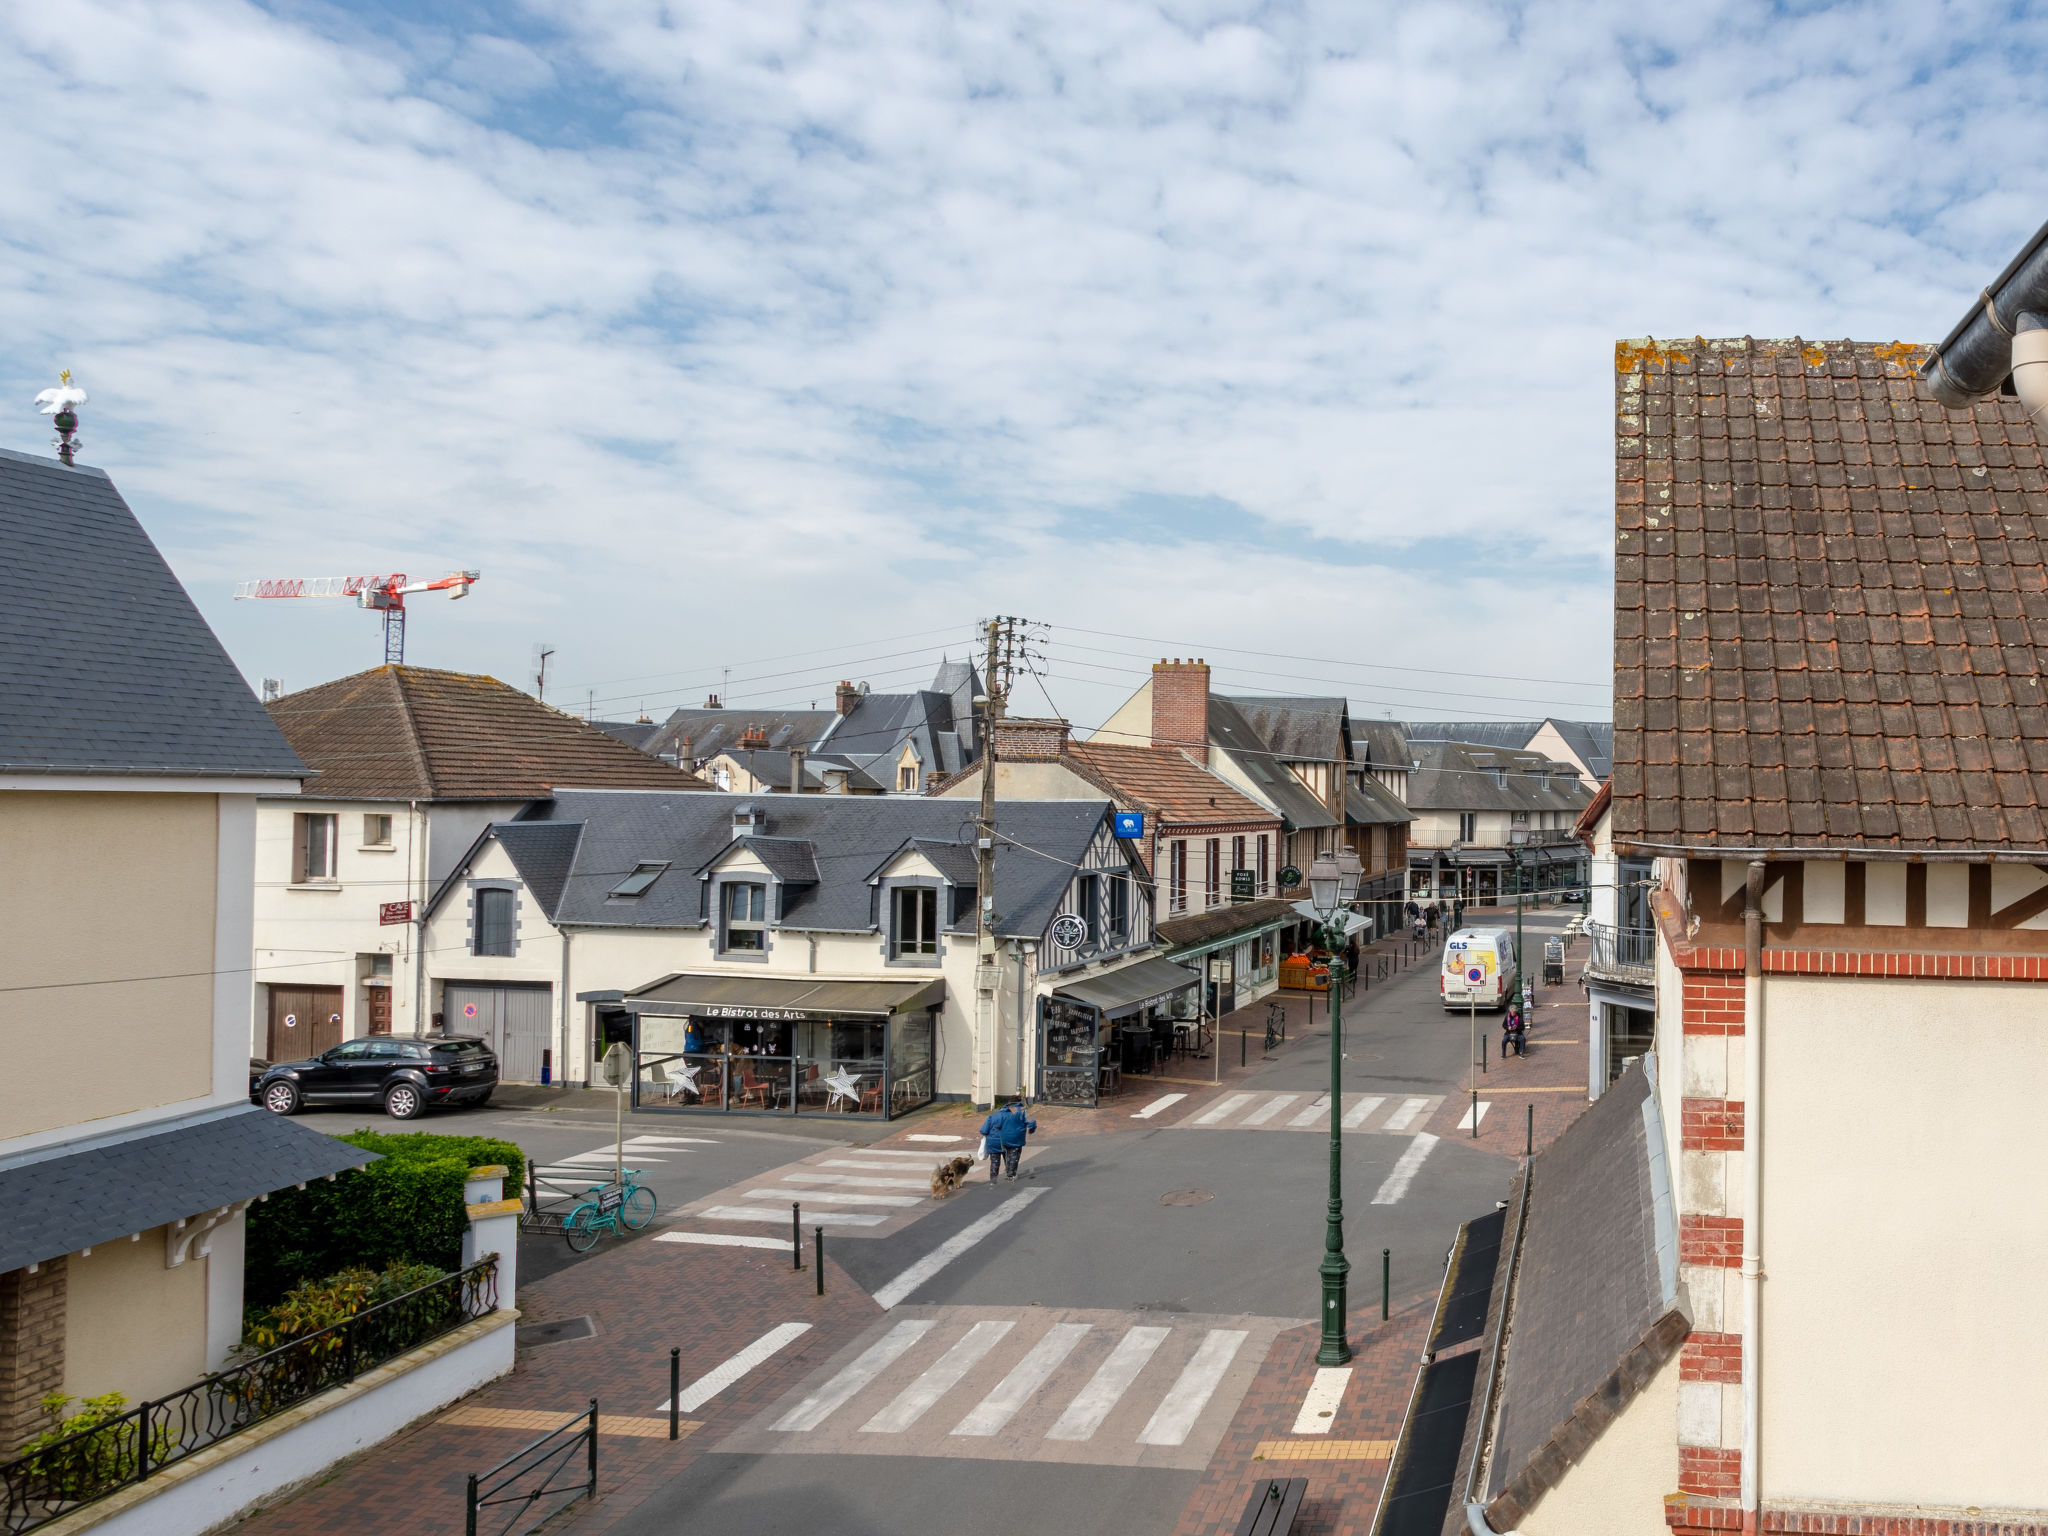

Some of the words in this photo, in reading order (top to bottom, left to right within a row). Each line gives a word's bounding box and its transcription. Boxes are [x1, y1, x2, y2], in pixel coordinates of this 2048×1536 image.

[390, 902, 408, 911] CAVE
[706, 1007, 719, 1017] Le
[721, 1007, 758, 1018] Bistrot
[760, 1009, 780, 1019] des
[783, 1010, 806, 1020] Arts
